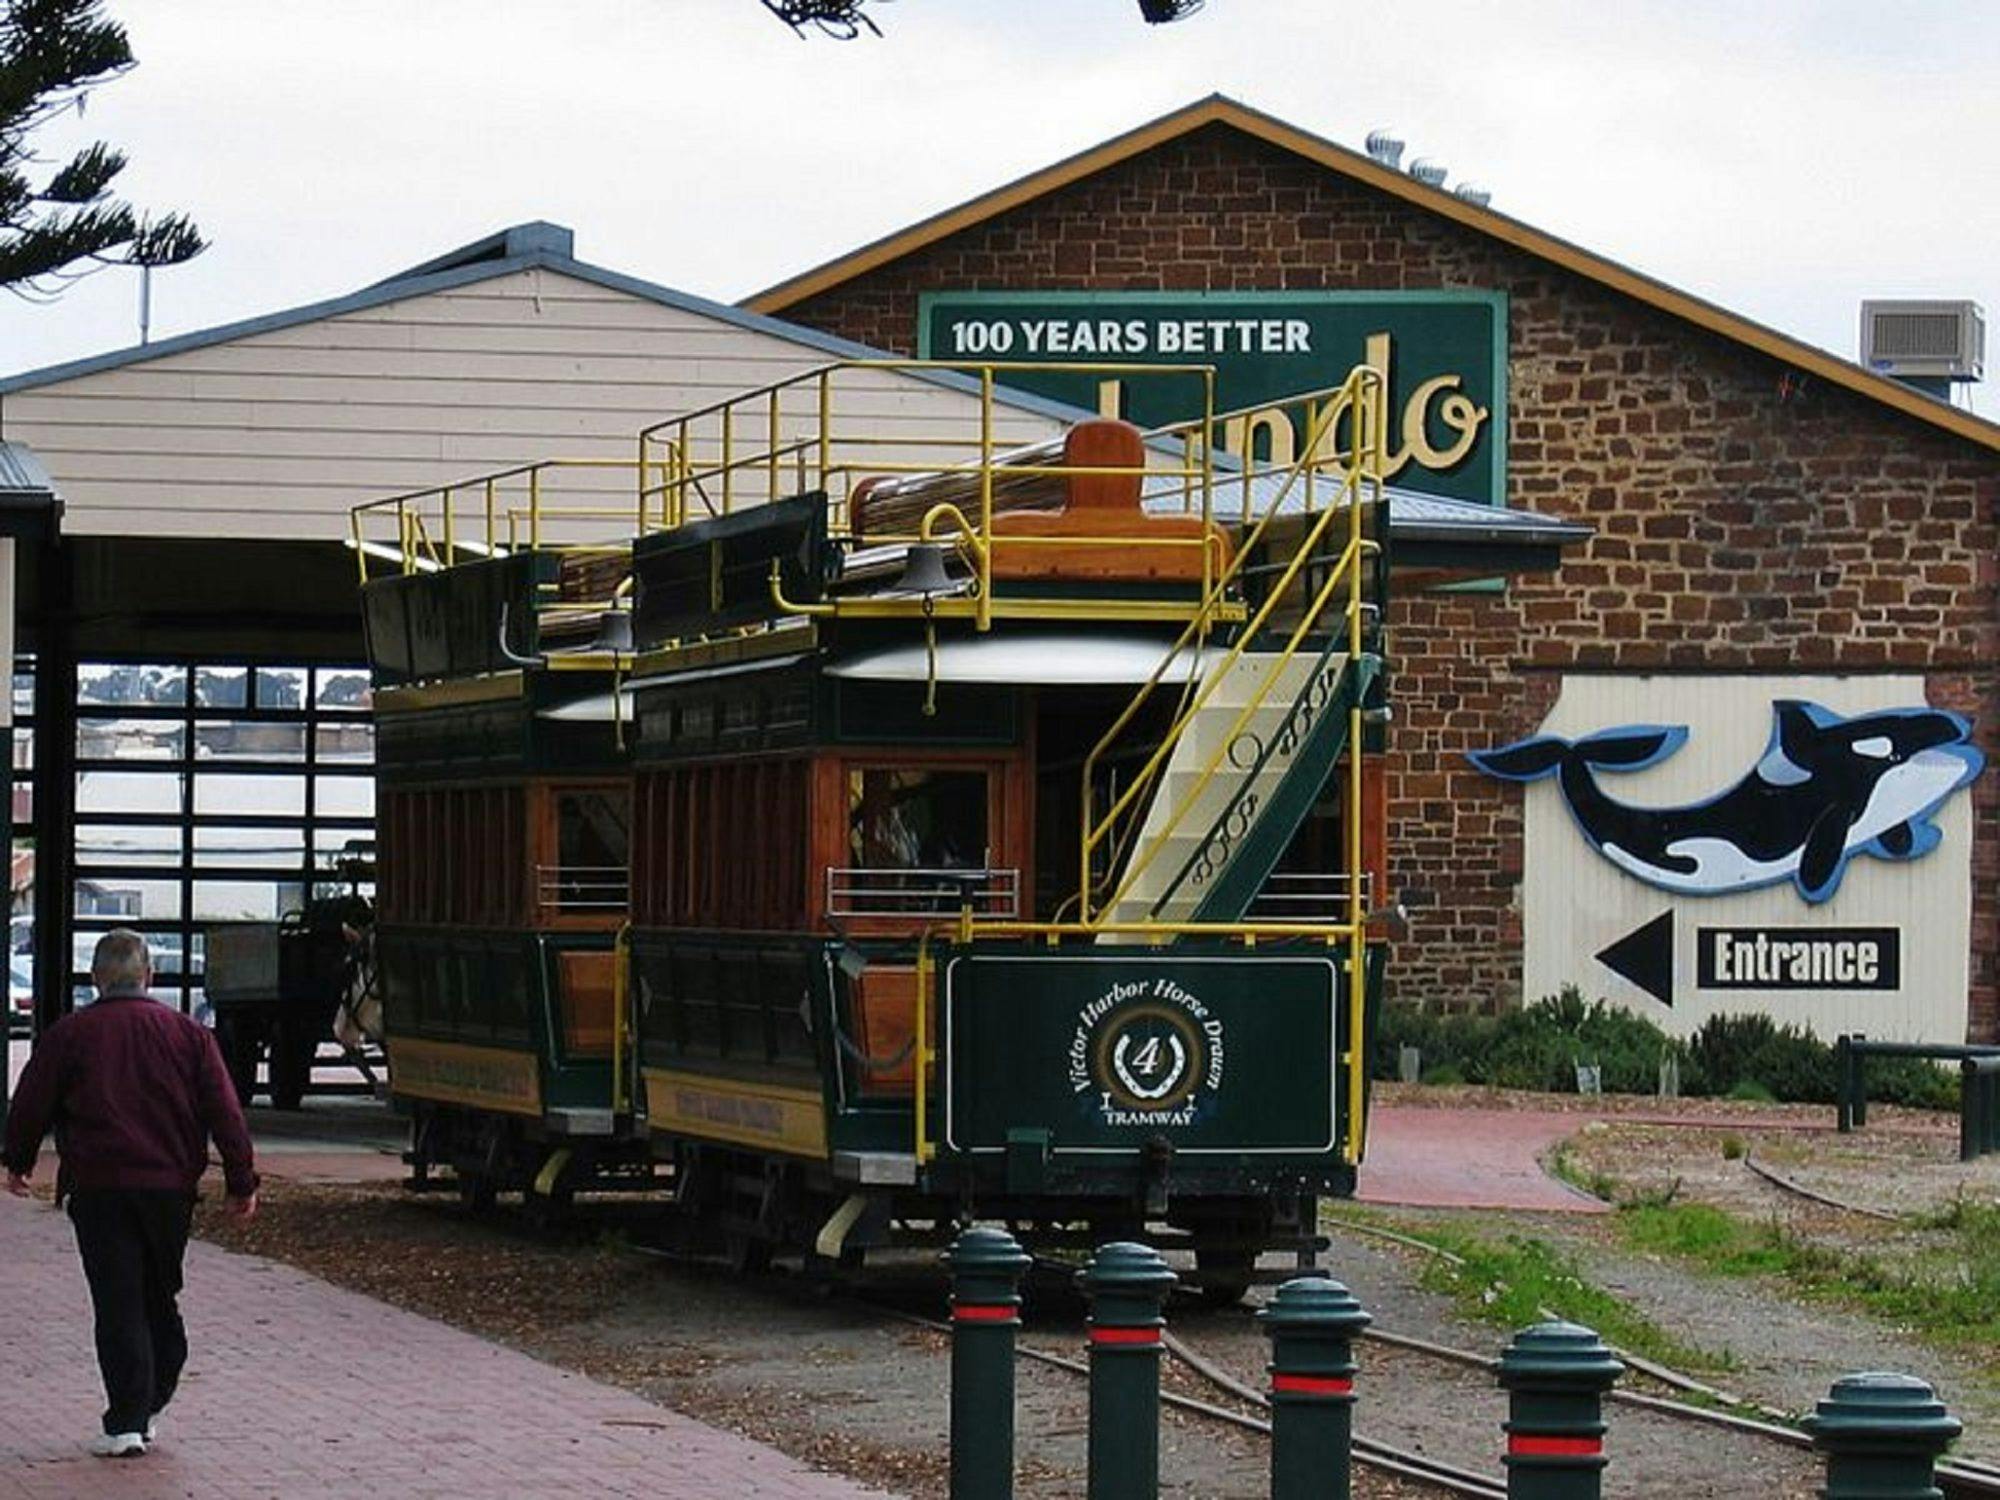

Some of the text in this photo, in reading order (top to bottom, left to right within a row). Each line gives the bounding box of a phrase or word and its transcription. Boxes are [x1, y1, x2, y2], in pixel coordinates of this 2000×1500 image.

[952, 320, 1311, 352] 100 YEARS BETTER
[1714, 932, 1879, 982] Entrance
[1069, 979, 1224, 1093] Victor Harbor Horse Drawn
[1132, 1037, 1160, 1075] 4
[1104, 1112, 1193, 1126] TRAMWAY
